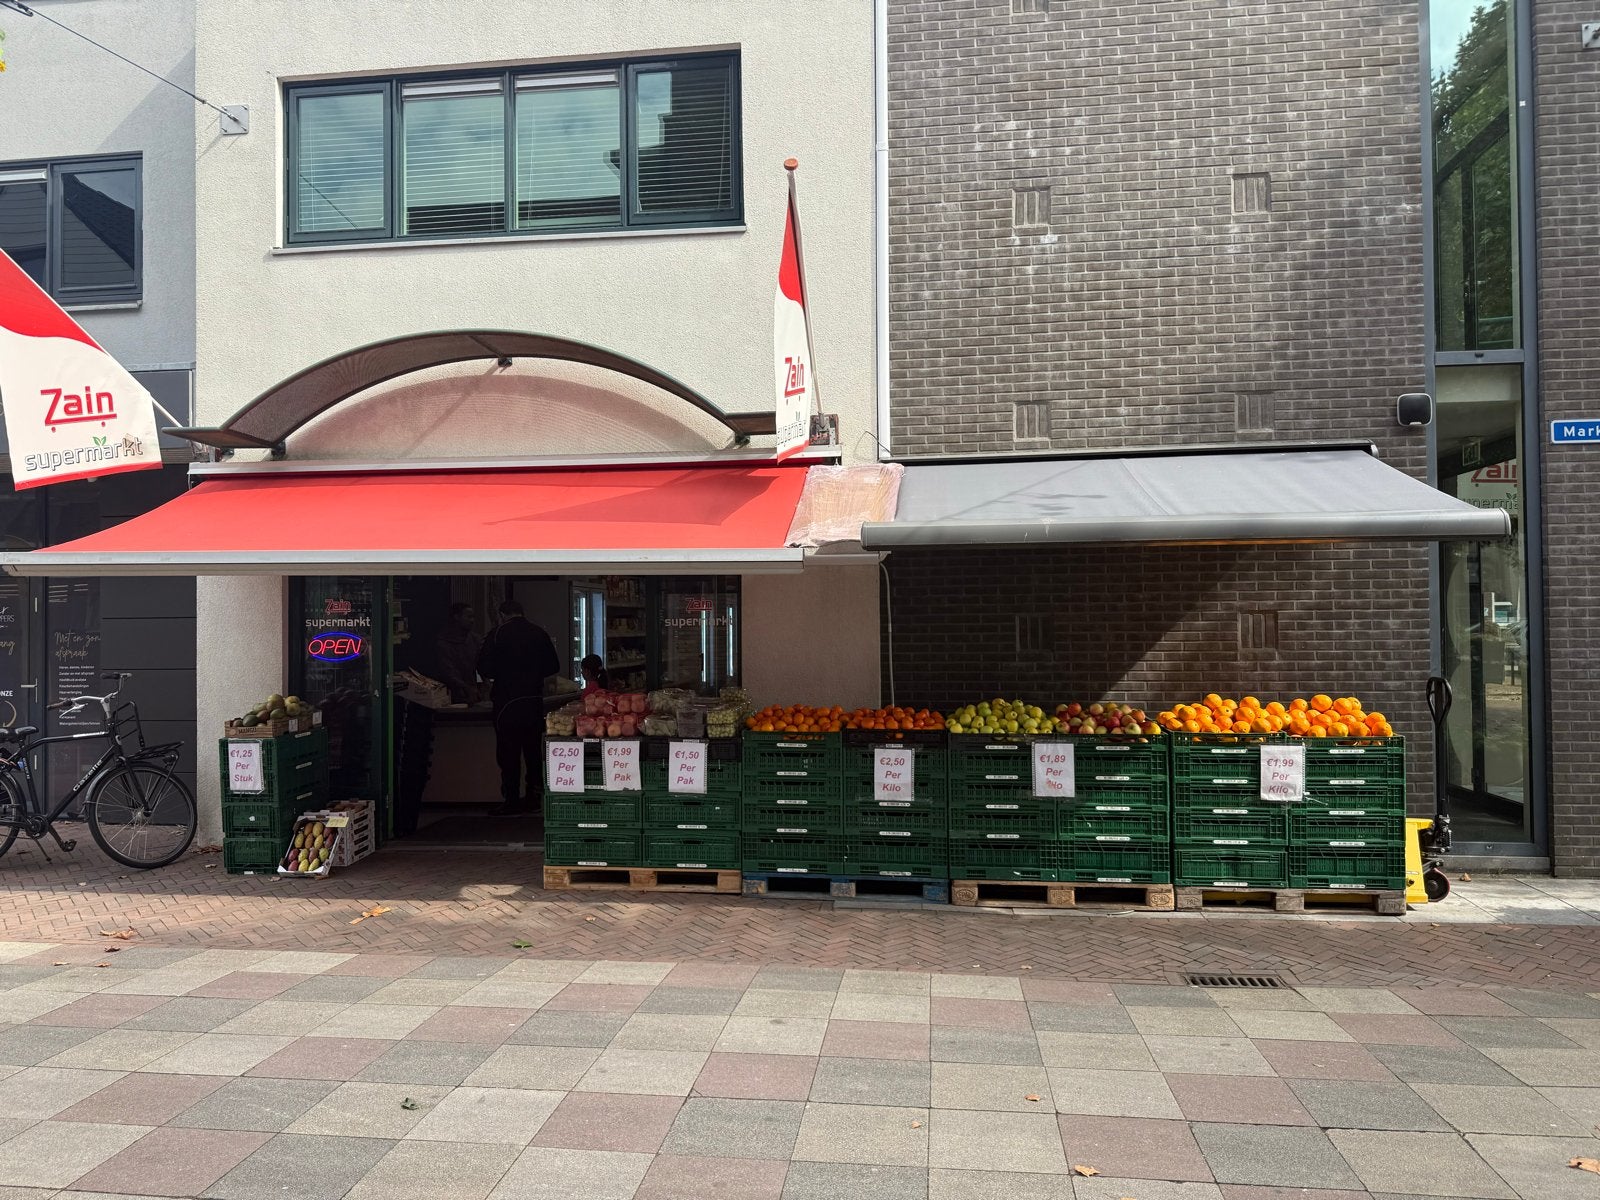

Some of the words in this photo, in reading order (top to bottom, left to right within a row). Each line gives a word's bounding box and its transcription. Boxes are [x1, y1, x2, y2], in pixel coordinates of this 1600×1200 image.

[784, 356, 805, 398] Zain
[40, 385, 117, 427] Zain
[24, 437, 144, 471] supermarkt
[324, 598, 352, 614] Zain
[684, 597, 713, 612] Zain
[305, 617, 371, 630] supermarkt
[308, 639, 361, 655] OPEN
[230, 750, 253, 758] €1,25
[552, 748, 580, 757] €2,50
[607, 748, 632, 756] €1,99
[675, 751, 700, 760] €1,50
[880, 757, 905, 767] €2,50
[1040, 755, 1066, 764] €1,89
[1267, 759, 1294, 768] €1,99
[558, 763, 576, 772] Per
[613, 761, 629, 769] Per
[680, 764, 696, 772] Per
[885, 771, 901, 779] Per
[1046, 768, 1064, 776] Per
[1272, 772, 1289, 781] Per
[556, 777, 575, 786] Pak
[614, 774, 632, 782] Pak
[677, 777, 695, 785] Pak
[882, 784, 901, 792] Kilo
[1269, 785, 1289, 794] Kilo
